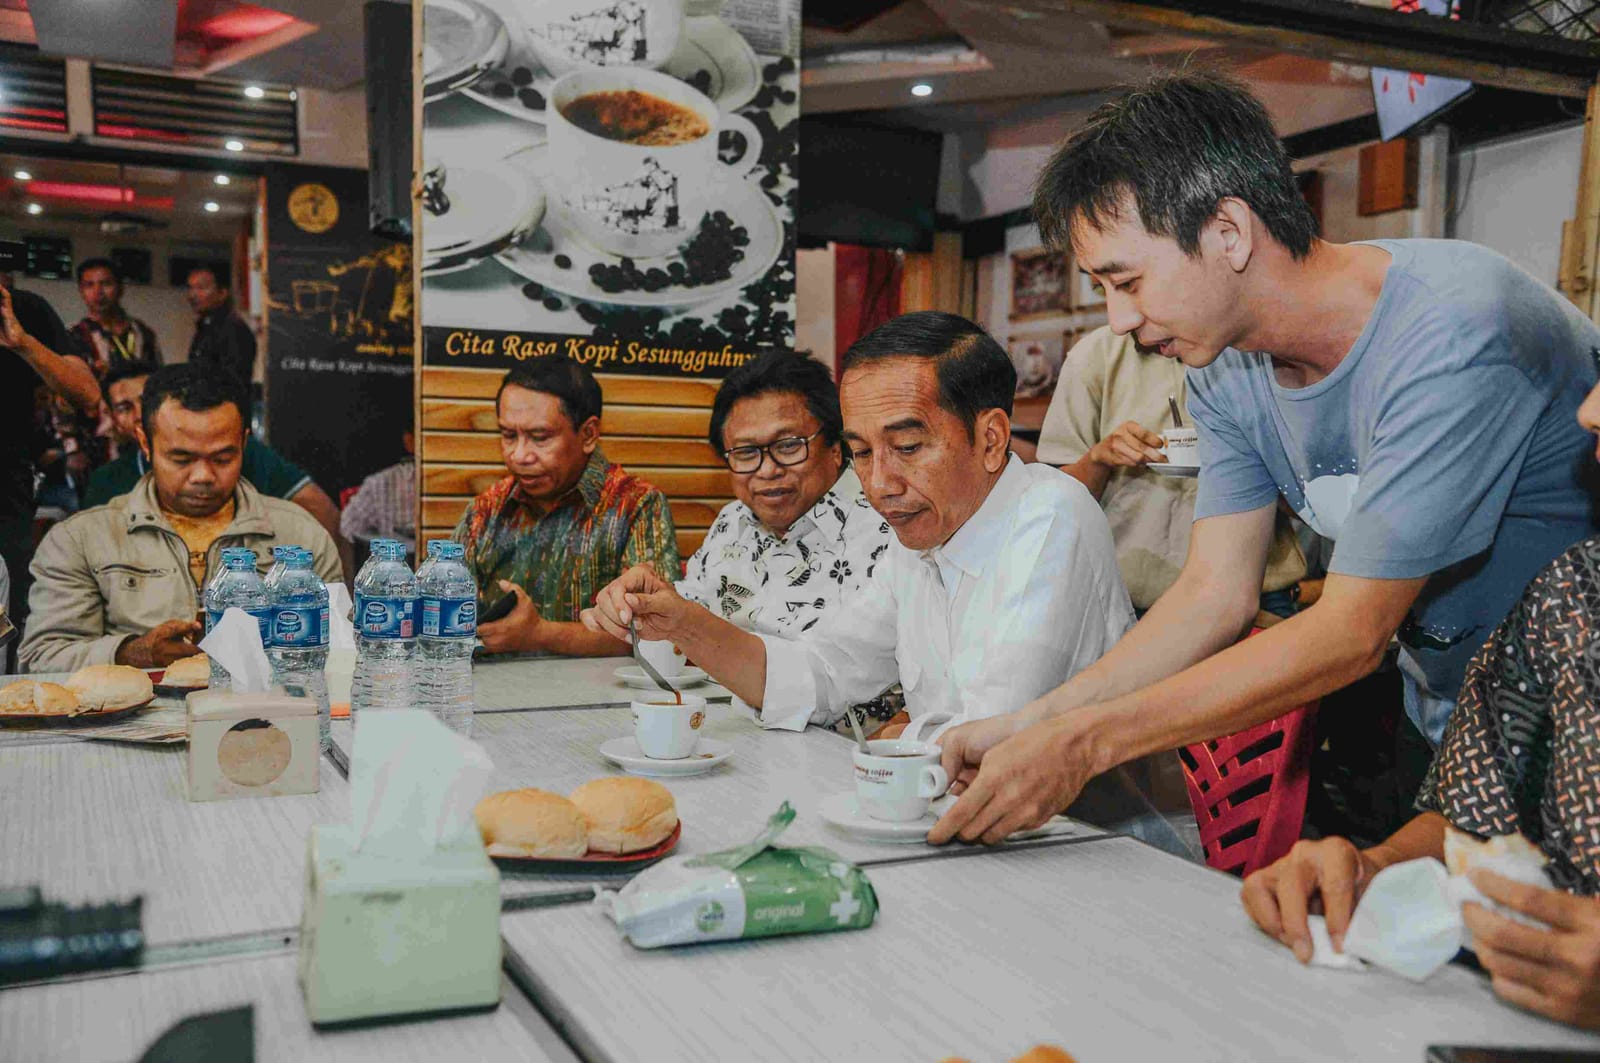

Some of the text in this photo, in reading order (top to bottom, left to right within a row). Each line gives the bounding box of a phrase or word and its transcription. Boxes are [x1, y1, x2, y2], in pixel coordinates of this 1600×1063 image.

[445, 331, 495, 356] Cita
[502, 334, 558, 361] Rasa
[564, 338, 619, 370] Kopi
[753, 902, 806, 922] original
